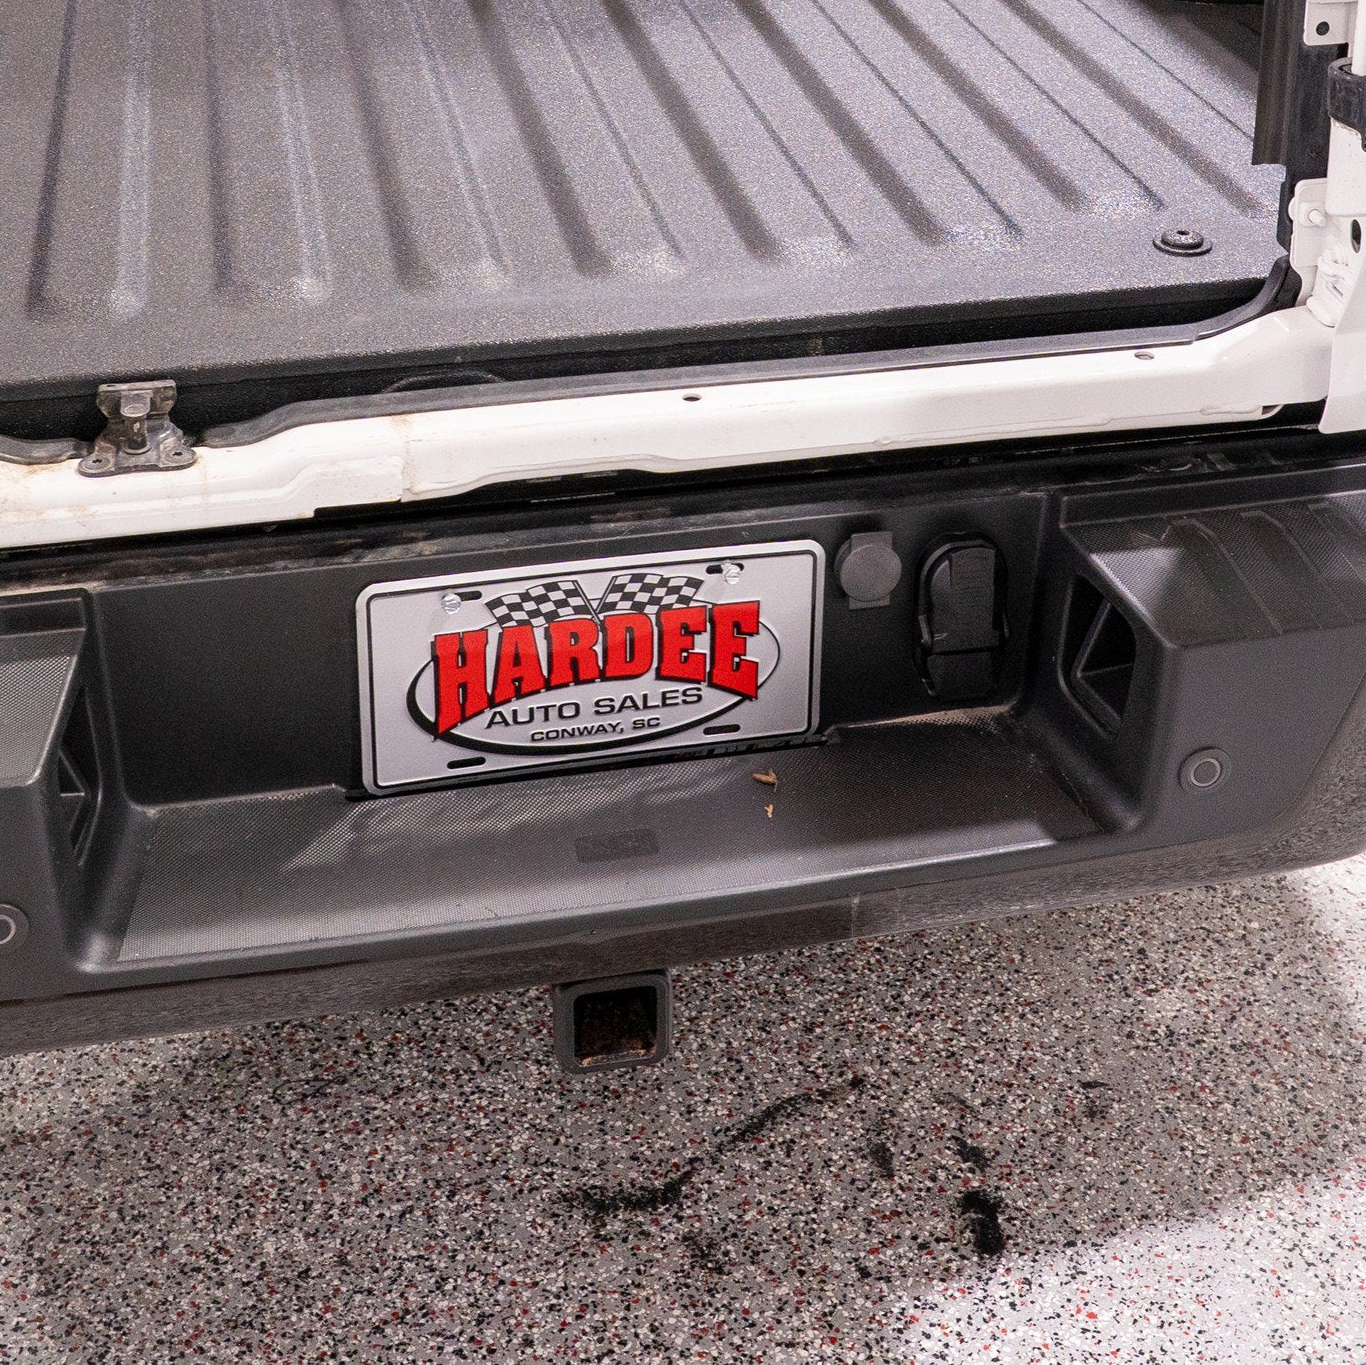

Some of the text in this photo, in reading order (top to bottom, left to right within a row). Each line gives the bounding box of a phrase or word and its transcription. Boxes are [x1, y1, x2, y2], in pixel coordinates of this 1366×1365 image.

[432, 600, 760, 735] HARDEE
[485, 685, 703, 729] AUTO SALES
[530, 716, 661, 743] CONWAY, SC
